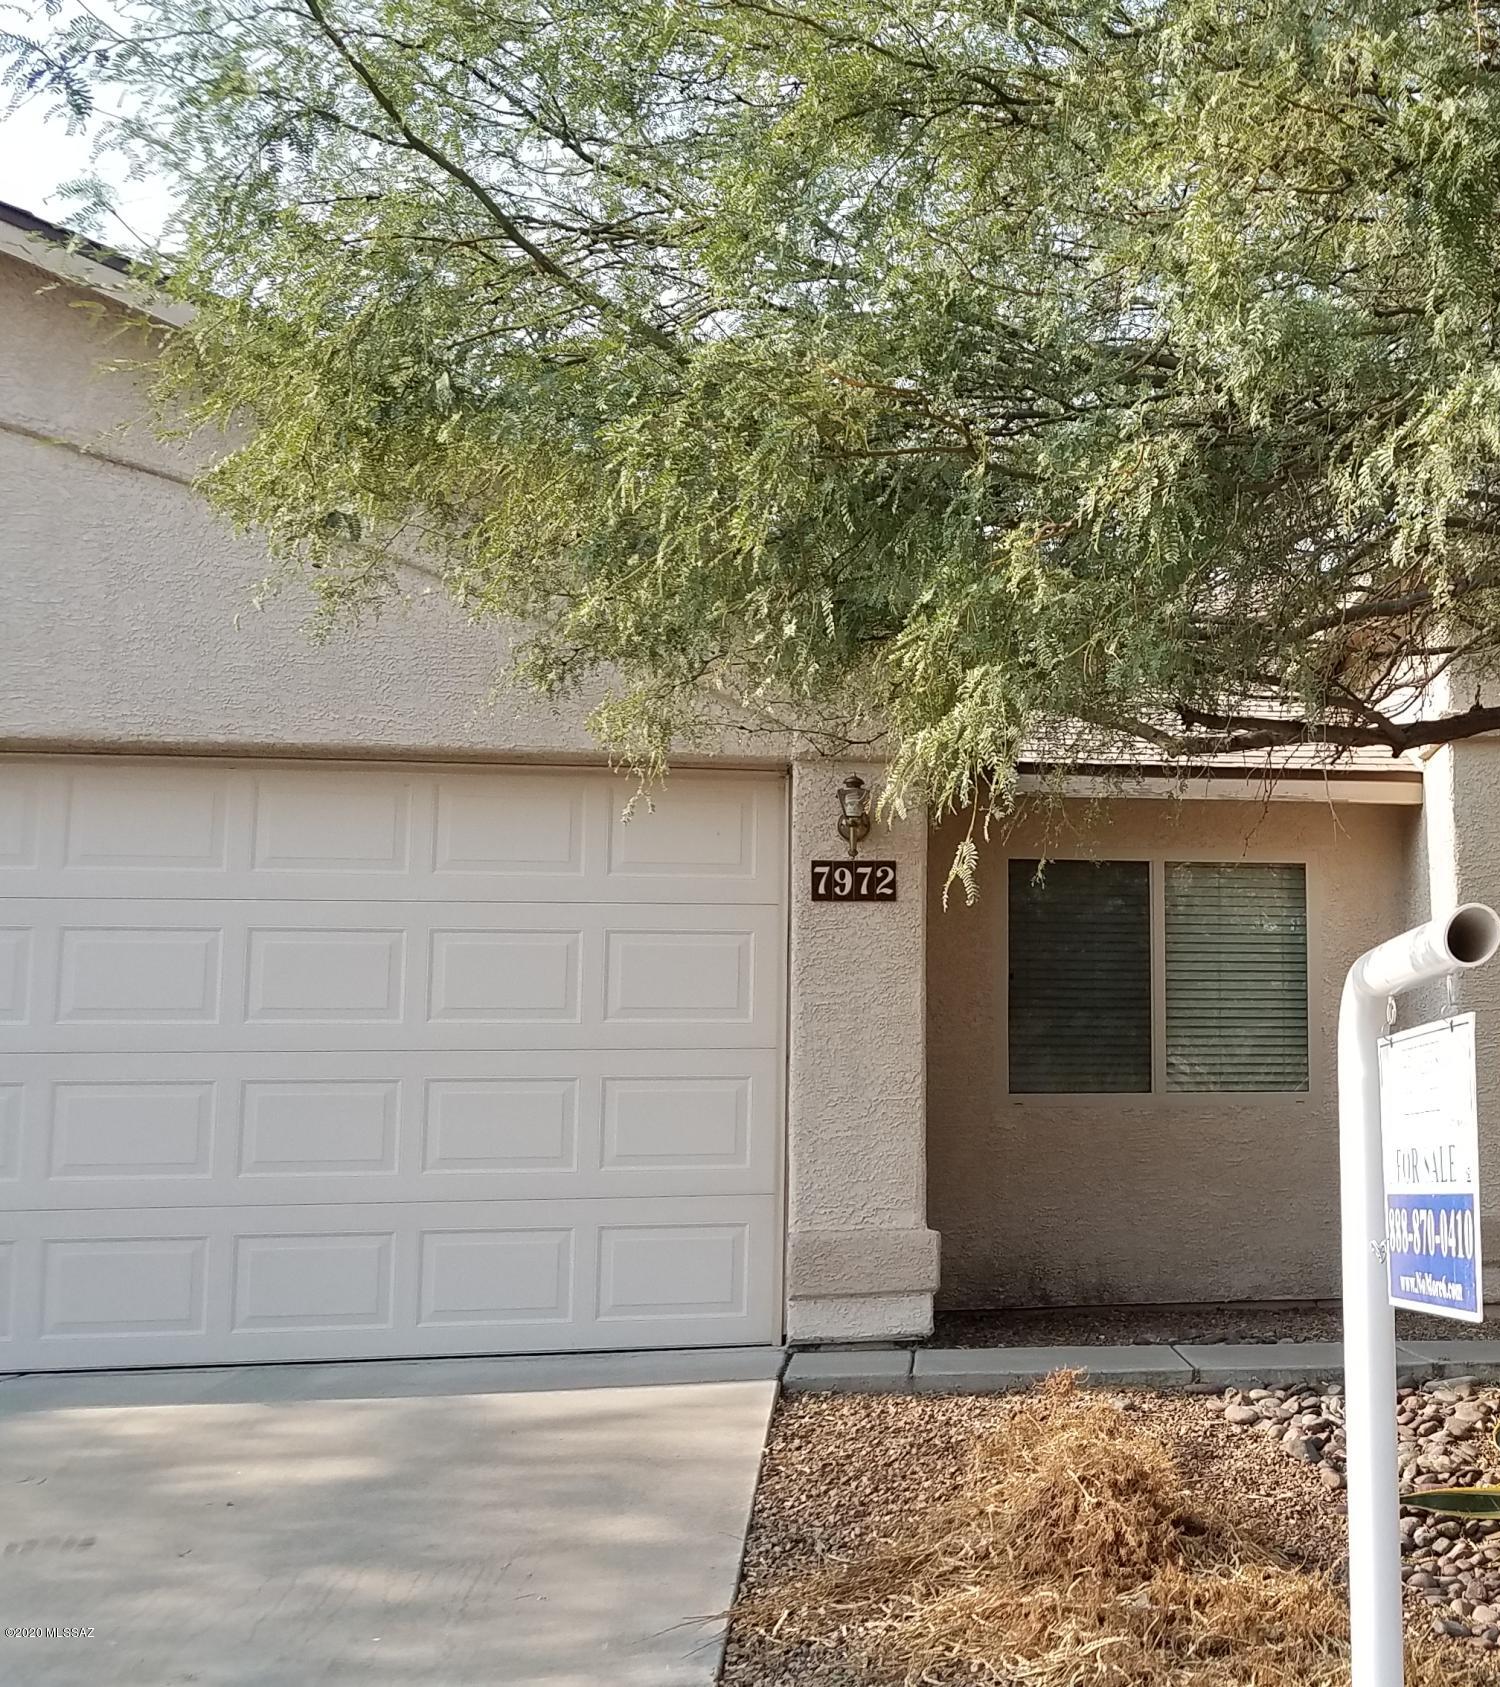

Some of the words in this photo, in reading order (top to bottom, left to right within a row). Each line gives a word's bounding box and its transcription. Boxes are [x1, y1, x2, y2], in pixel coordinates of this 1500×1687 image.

[813, 866, 895, 896] 7972
[1396, 1147, 1420, 1184] FOR
[1388, 1207, 1474, 1260] 888-870-0410
